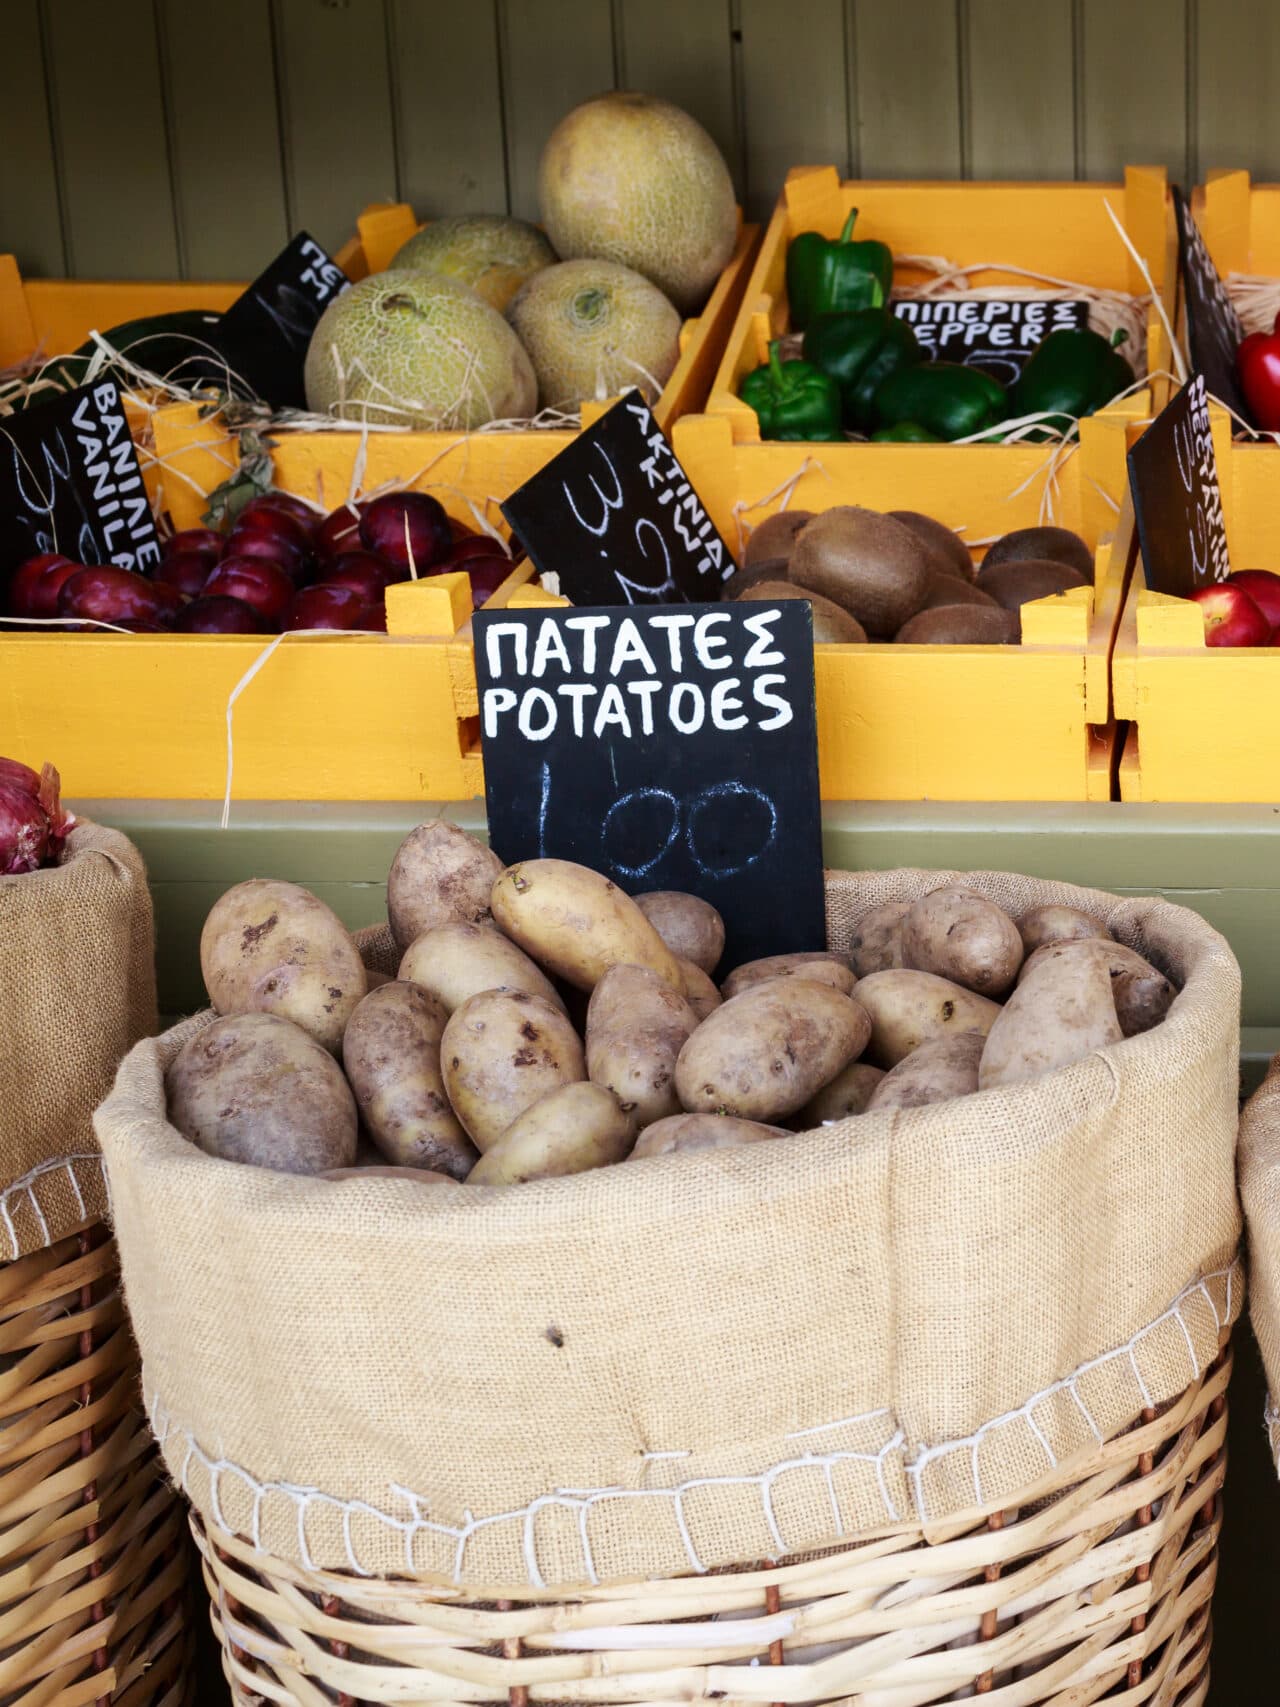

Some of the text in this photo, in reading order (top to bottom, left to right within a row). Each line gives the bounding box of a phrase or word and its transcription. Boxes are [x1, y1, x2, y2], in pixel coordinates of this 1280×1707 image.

[894, 302, 1078, 324] ΠΙΠΕΡΙΕΣ
[639, 456, 712, 575] KIWI
[485, 608, 787, 679] ΠΑΤΑΤΕΣ
[483, 673, 794, 742] POTATOES
